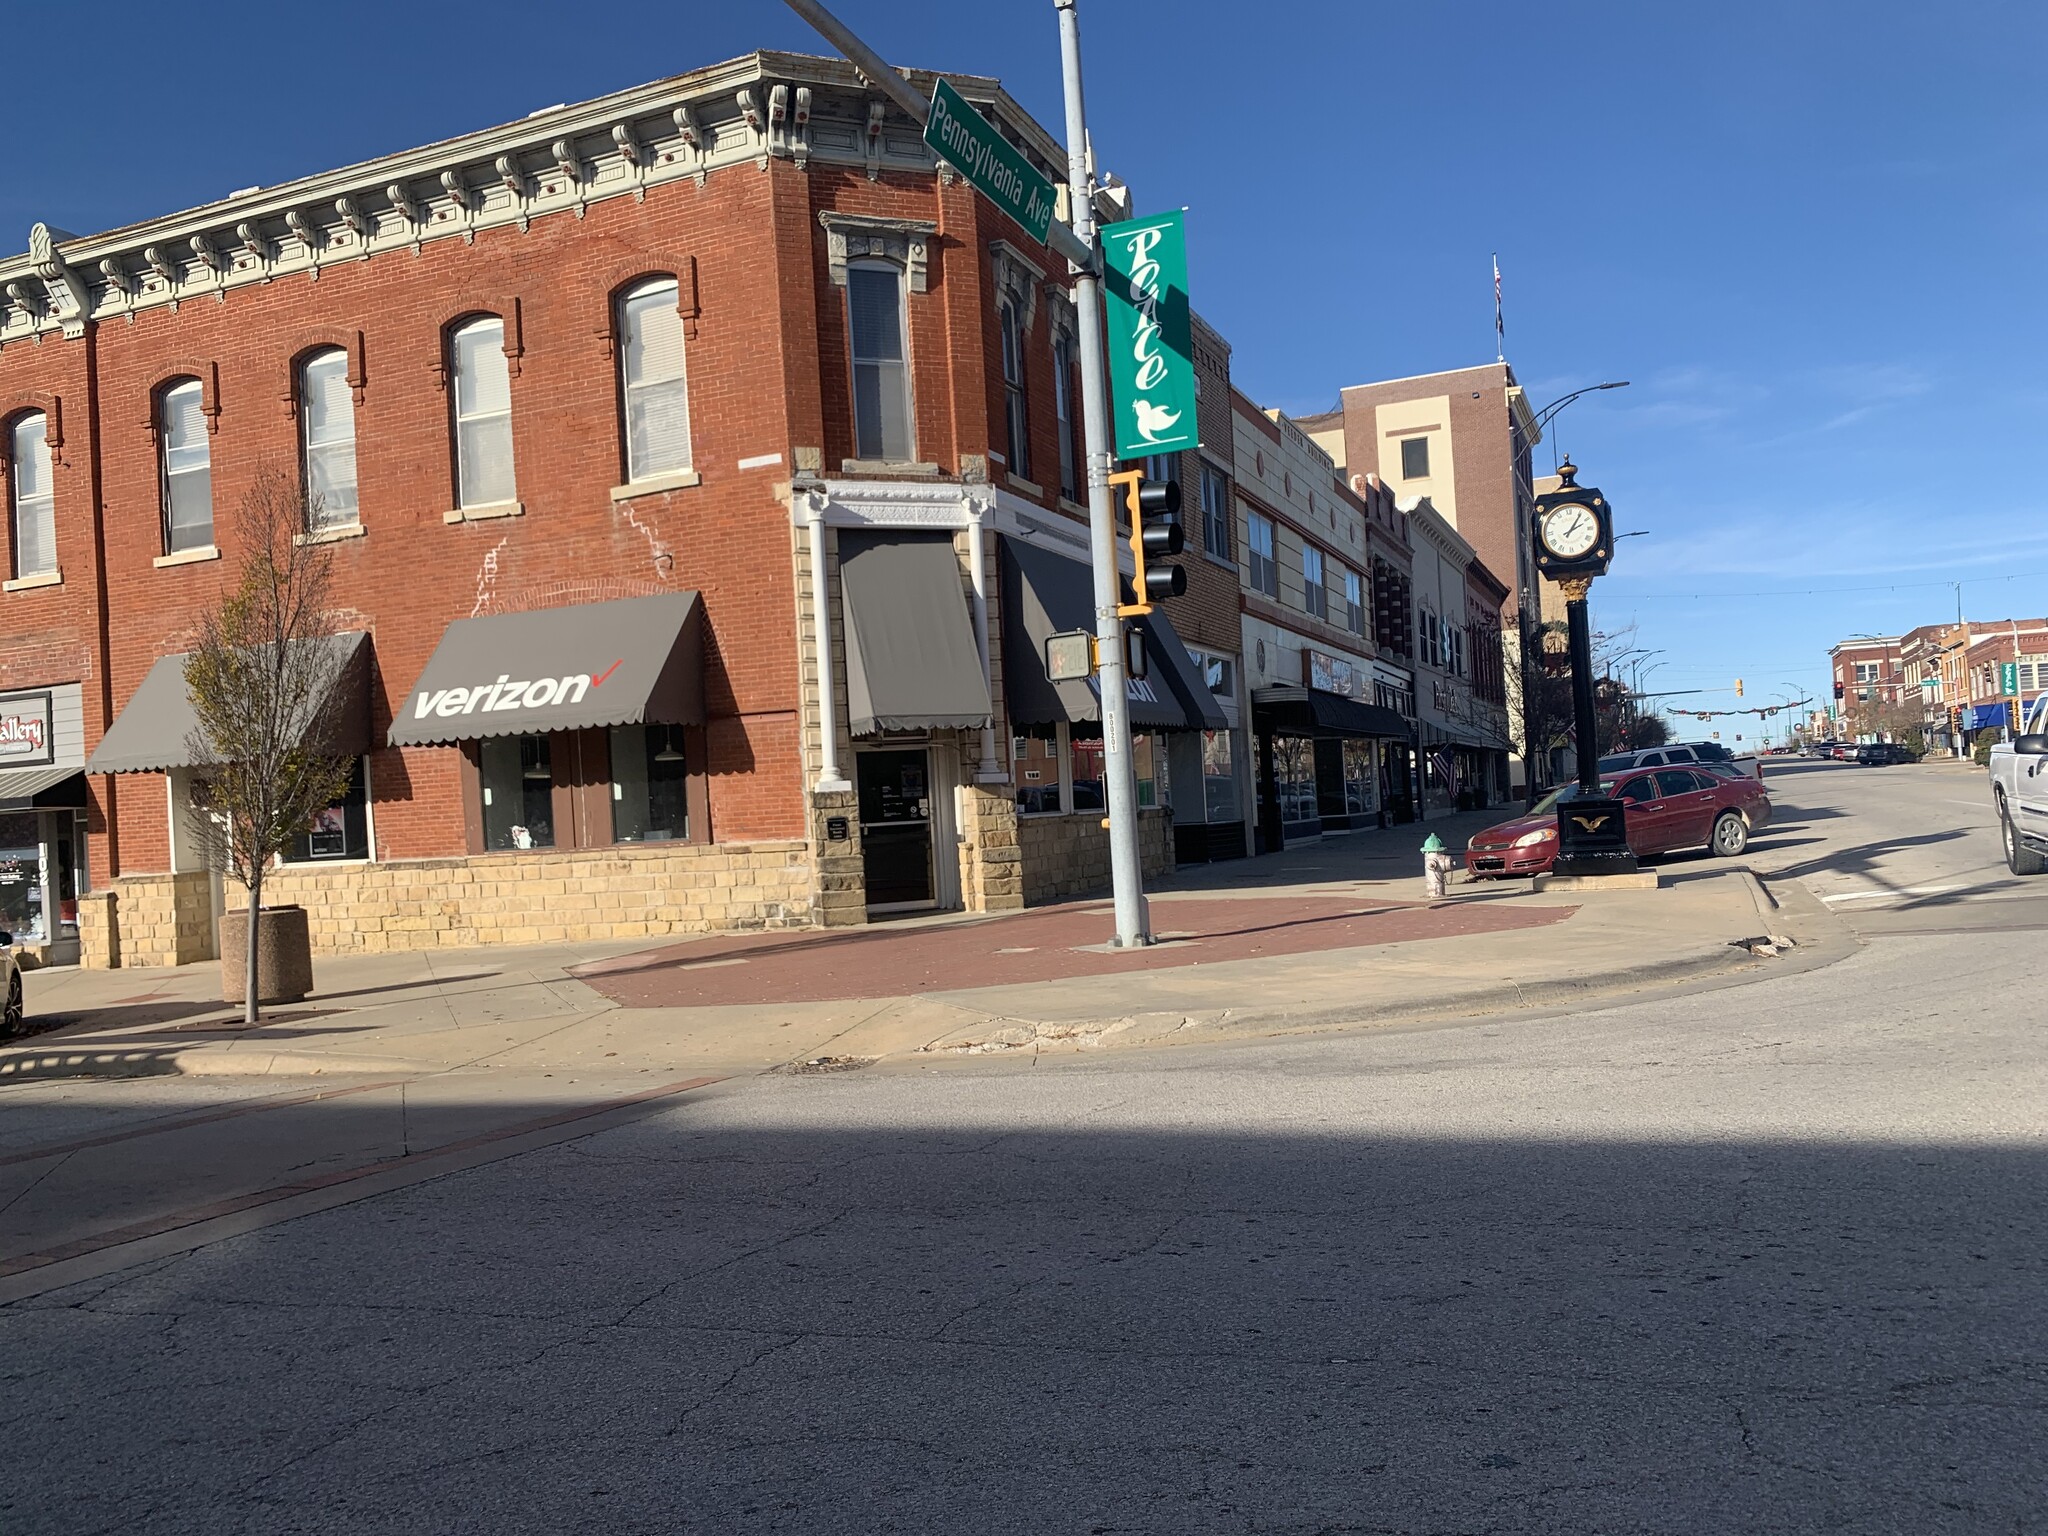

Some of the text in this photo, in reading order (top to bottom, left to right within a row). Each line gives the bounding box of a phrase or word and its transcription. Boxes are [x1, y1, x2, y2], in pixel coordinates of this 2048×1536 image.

[930, 95, 1050, 229] Pennsylvania Ave
[414, 673, 591, 720] verizon
[0, 716, 43, 746] allery
[38, 842, 48, 886] 102
